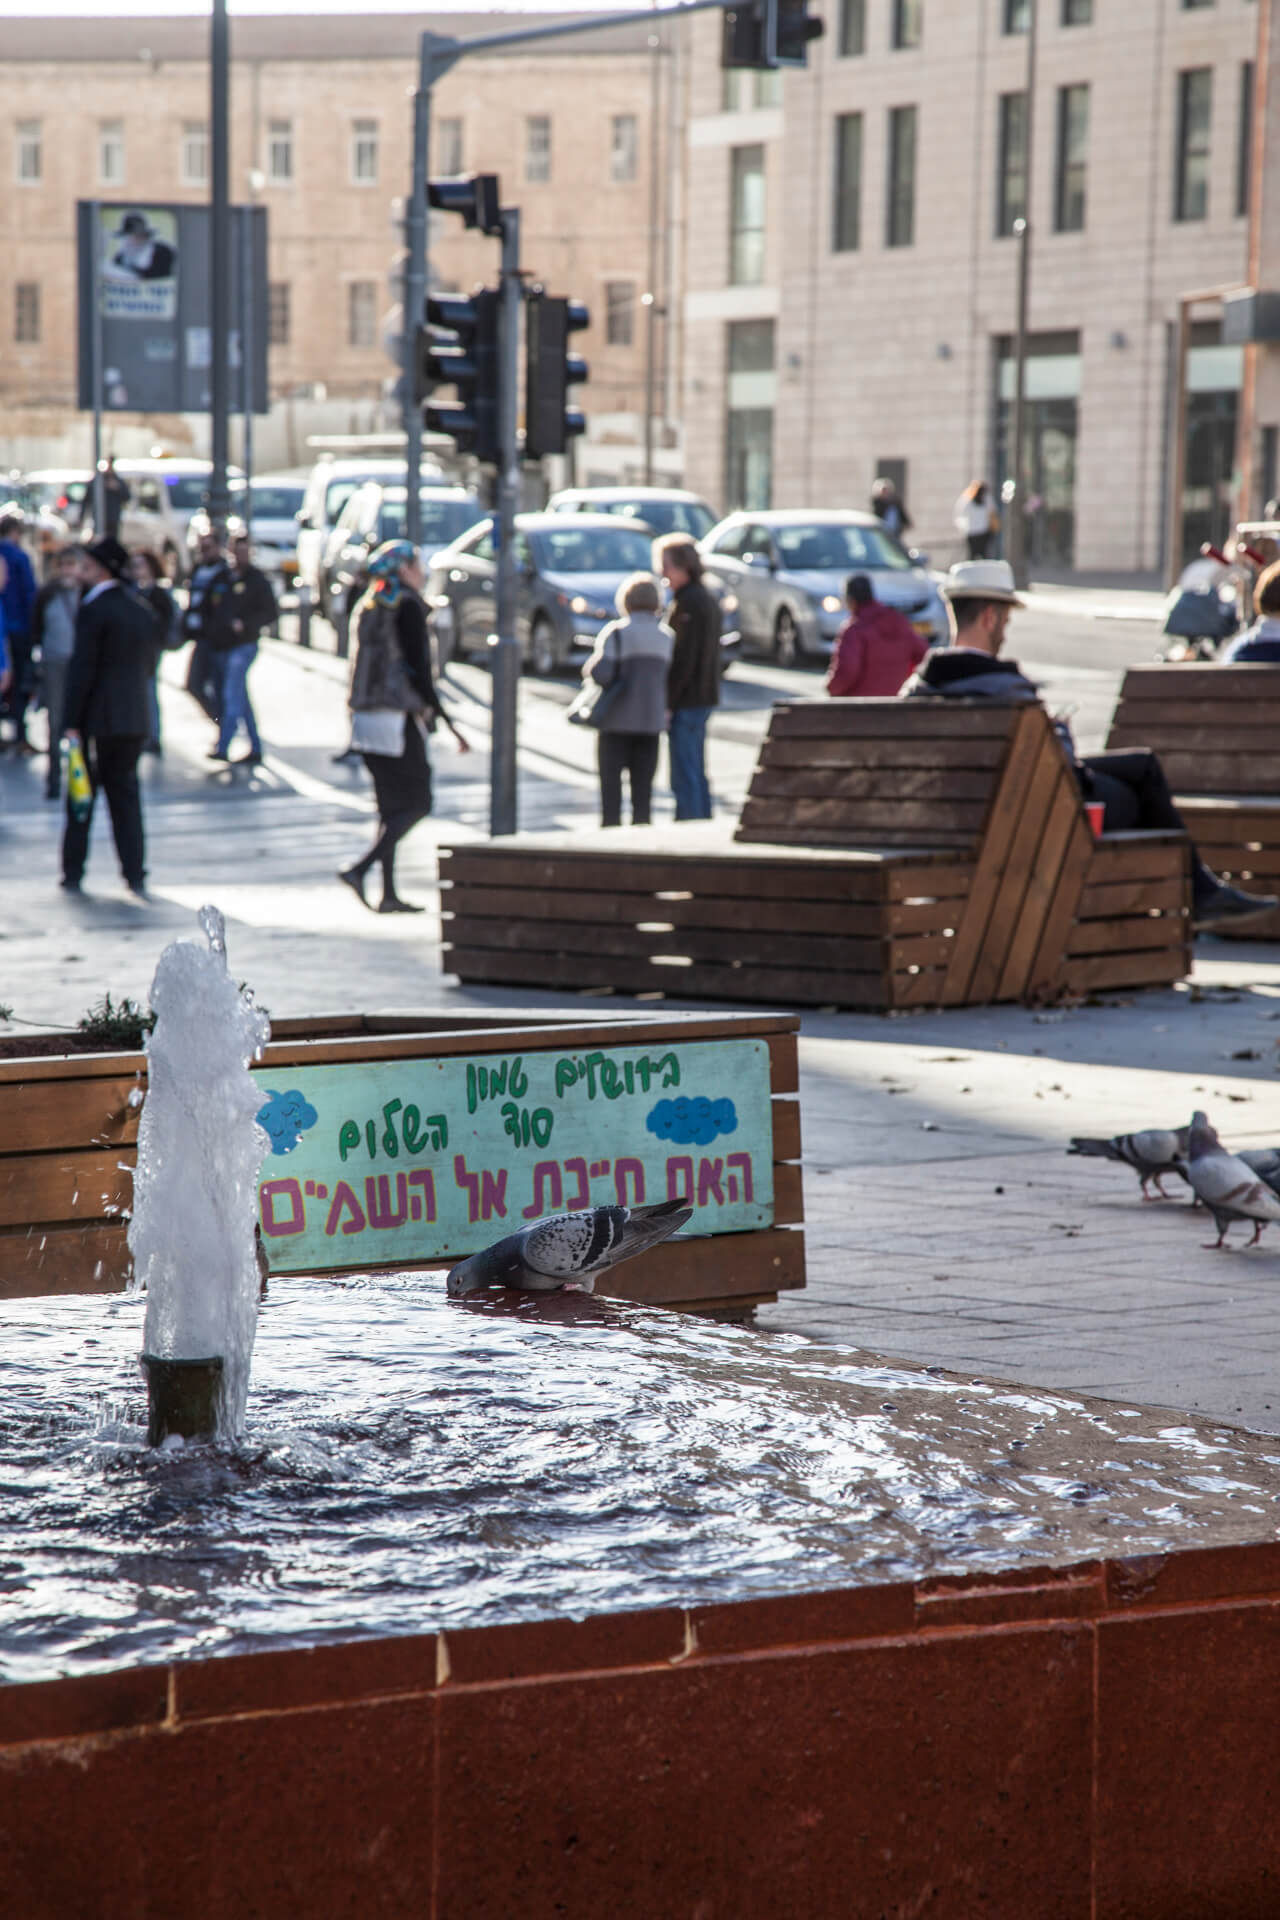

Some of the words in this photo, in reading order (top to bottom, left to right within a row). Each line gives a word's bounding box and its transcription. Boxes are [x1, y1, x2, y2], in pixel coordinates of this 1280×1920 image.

[466, 1056, 528, 1114] טמון
[555, 1051, 680, 1100] בירושלים
[339, 1098, 448, 1162] השלום
[501, 1102, 553, 1148] סוד
[259, 1168, 437, 1237] השמיים
[454, 1154, 508, 1224] אל
[522, 1157, 645, 1219] חייכת
[666, 1152, 753, 1207] האם
